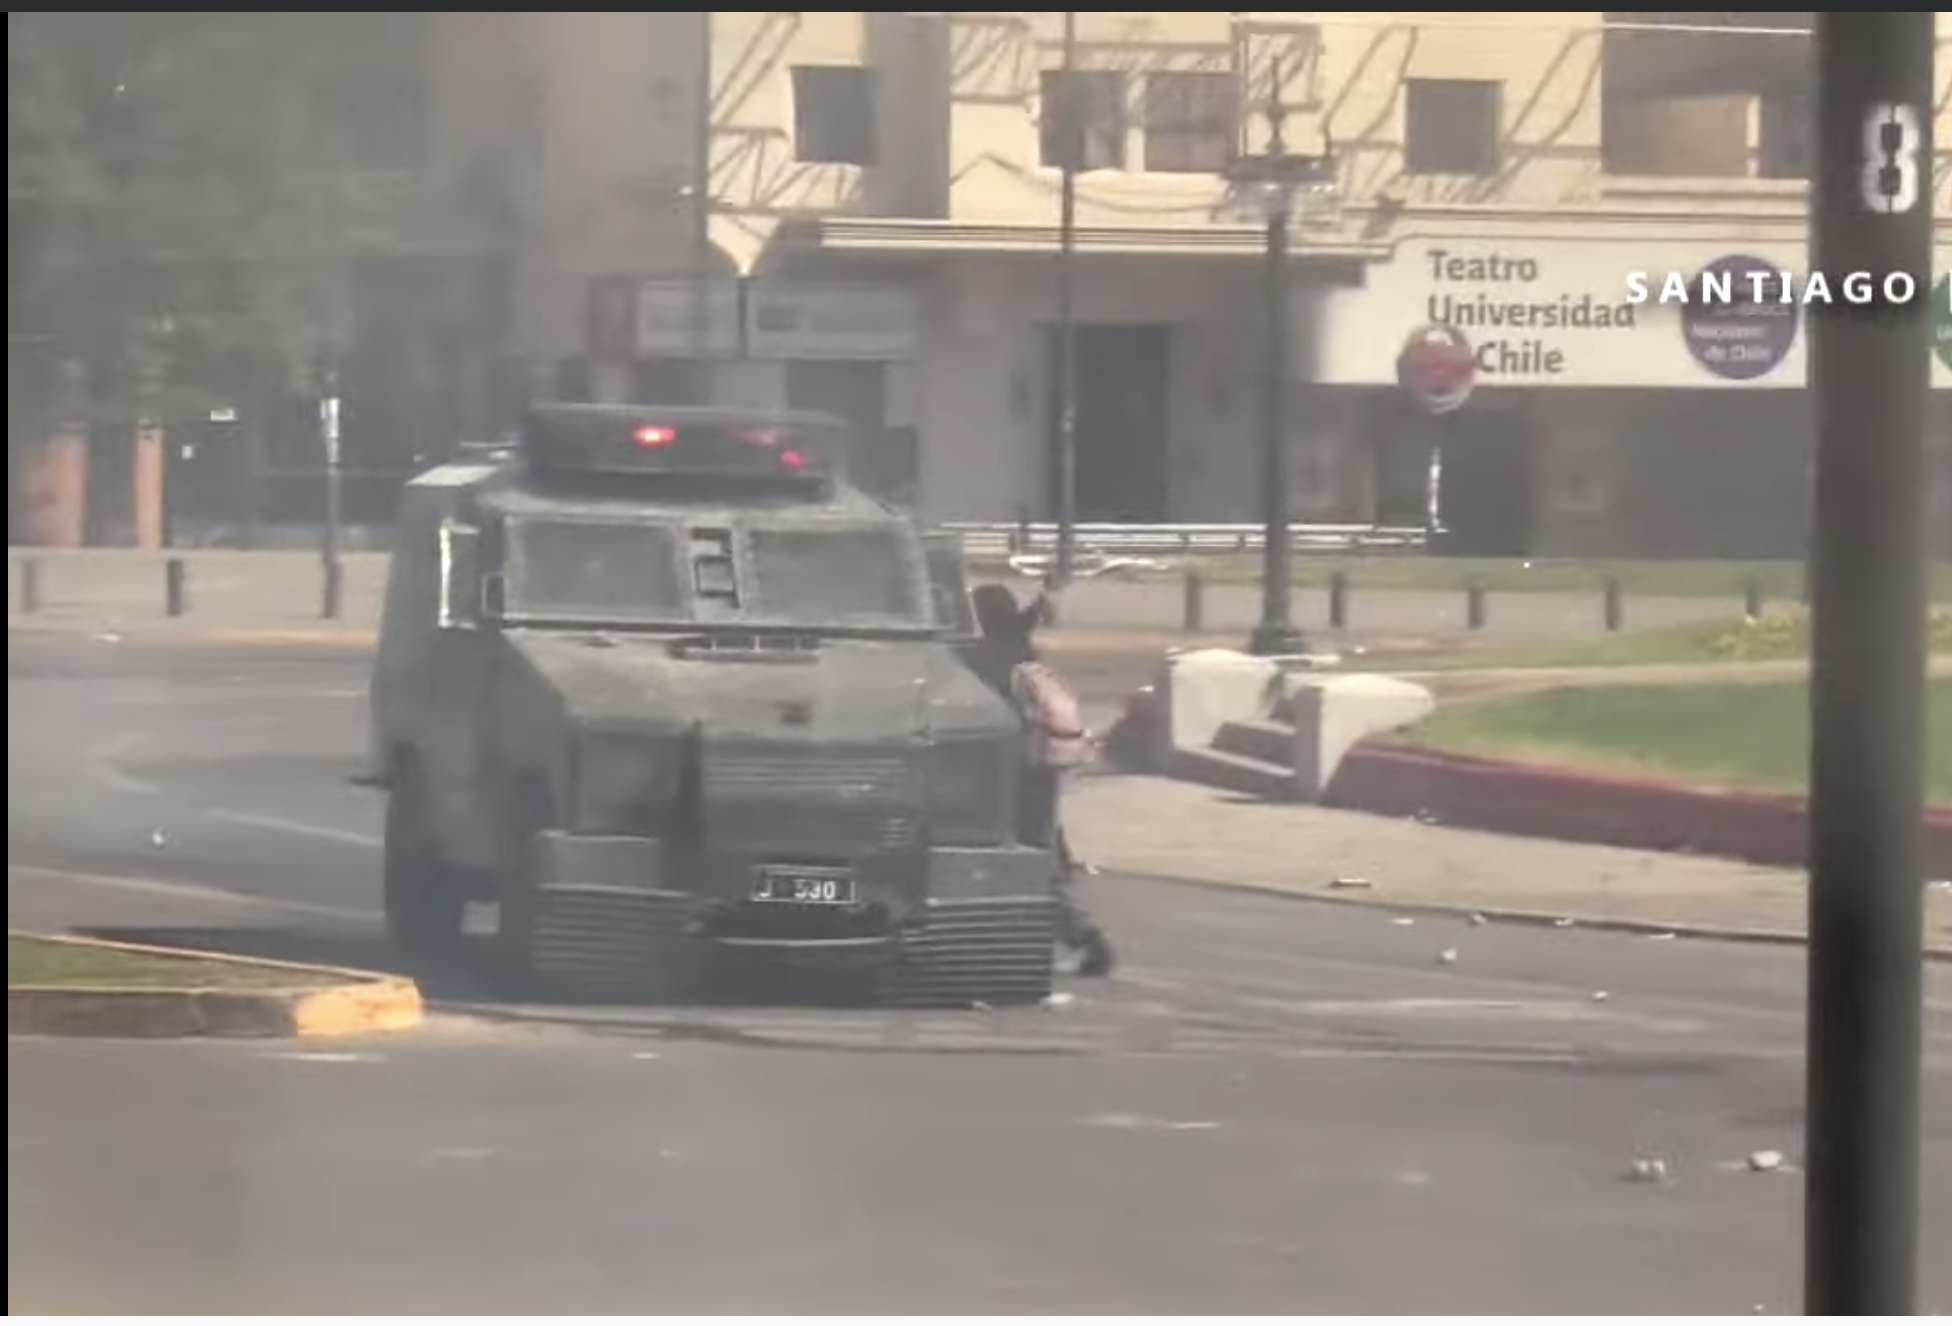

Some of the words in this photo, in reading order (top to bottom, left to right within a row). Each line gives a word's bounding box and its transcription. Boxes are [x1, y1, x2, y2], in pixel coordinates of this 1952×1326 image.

[1862, 103, 1919, 214] 8
[1427, 250, 1538, 282] Teatro
[1427, 294, 1635, 328] Universidad
[1476, 340, 1564, 373] Chile
